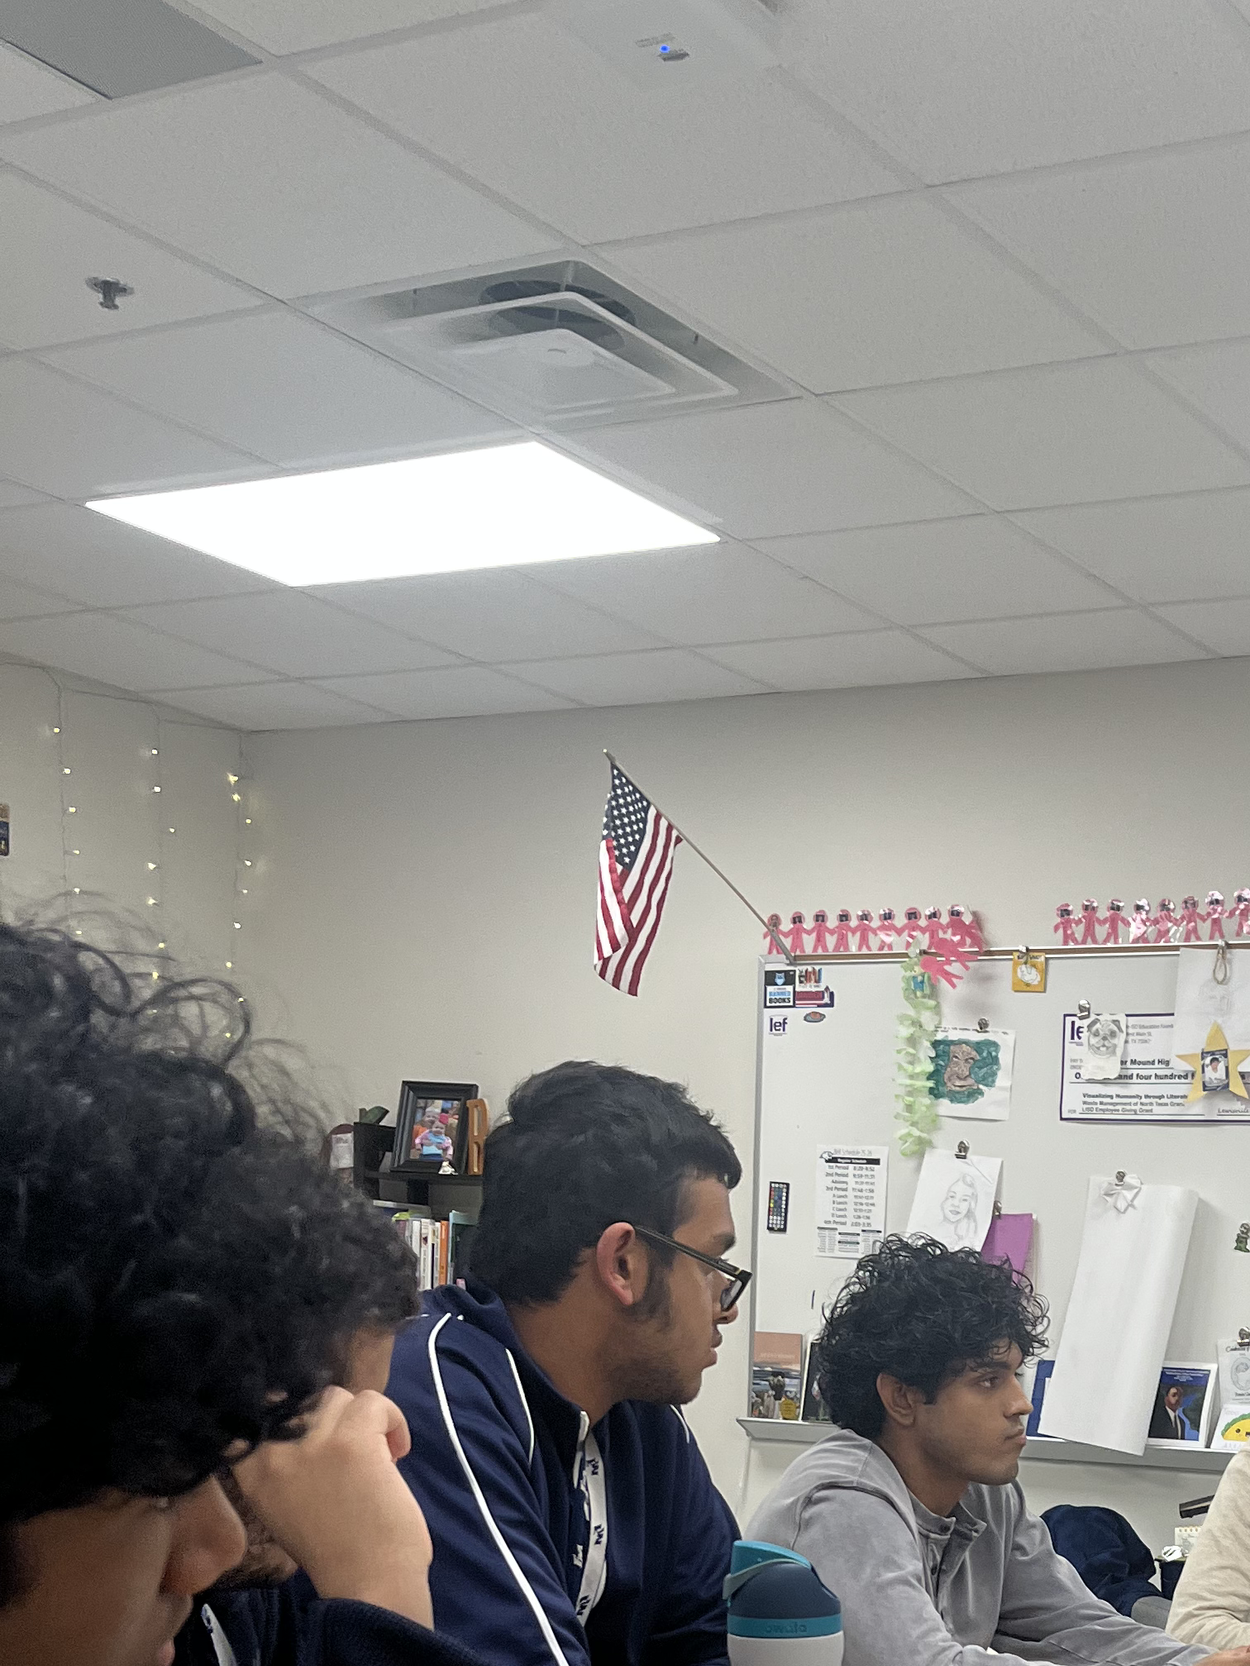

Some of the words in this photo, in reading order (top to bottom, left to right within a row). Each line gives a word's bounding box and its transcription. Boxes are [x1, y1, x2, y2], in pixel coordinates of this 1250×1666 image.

[769, 1017, 788, 1032] lef
[1070, 1020, 1084, 1040] le
[1157, 1059, 1171, 1067] Hig
[1154, 1072, 1188, 1080] hundred
